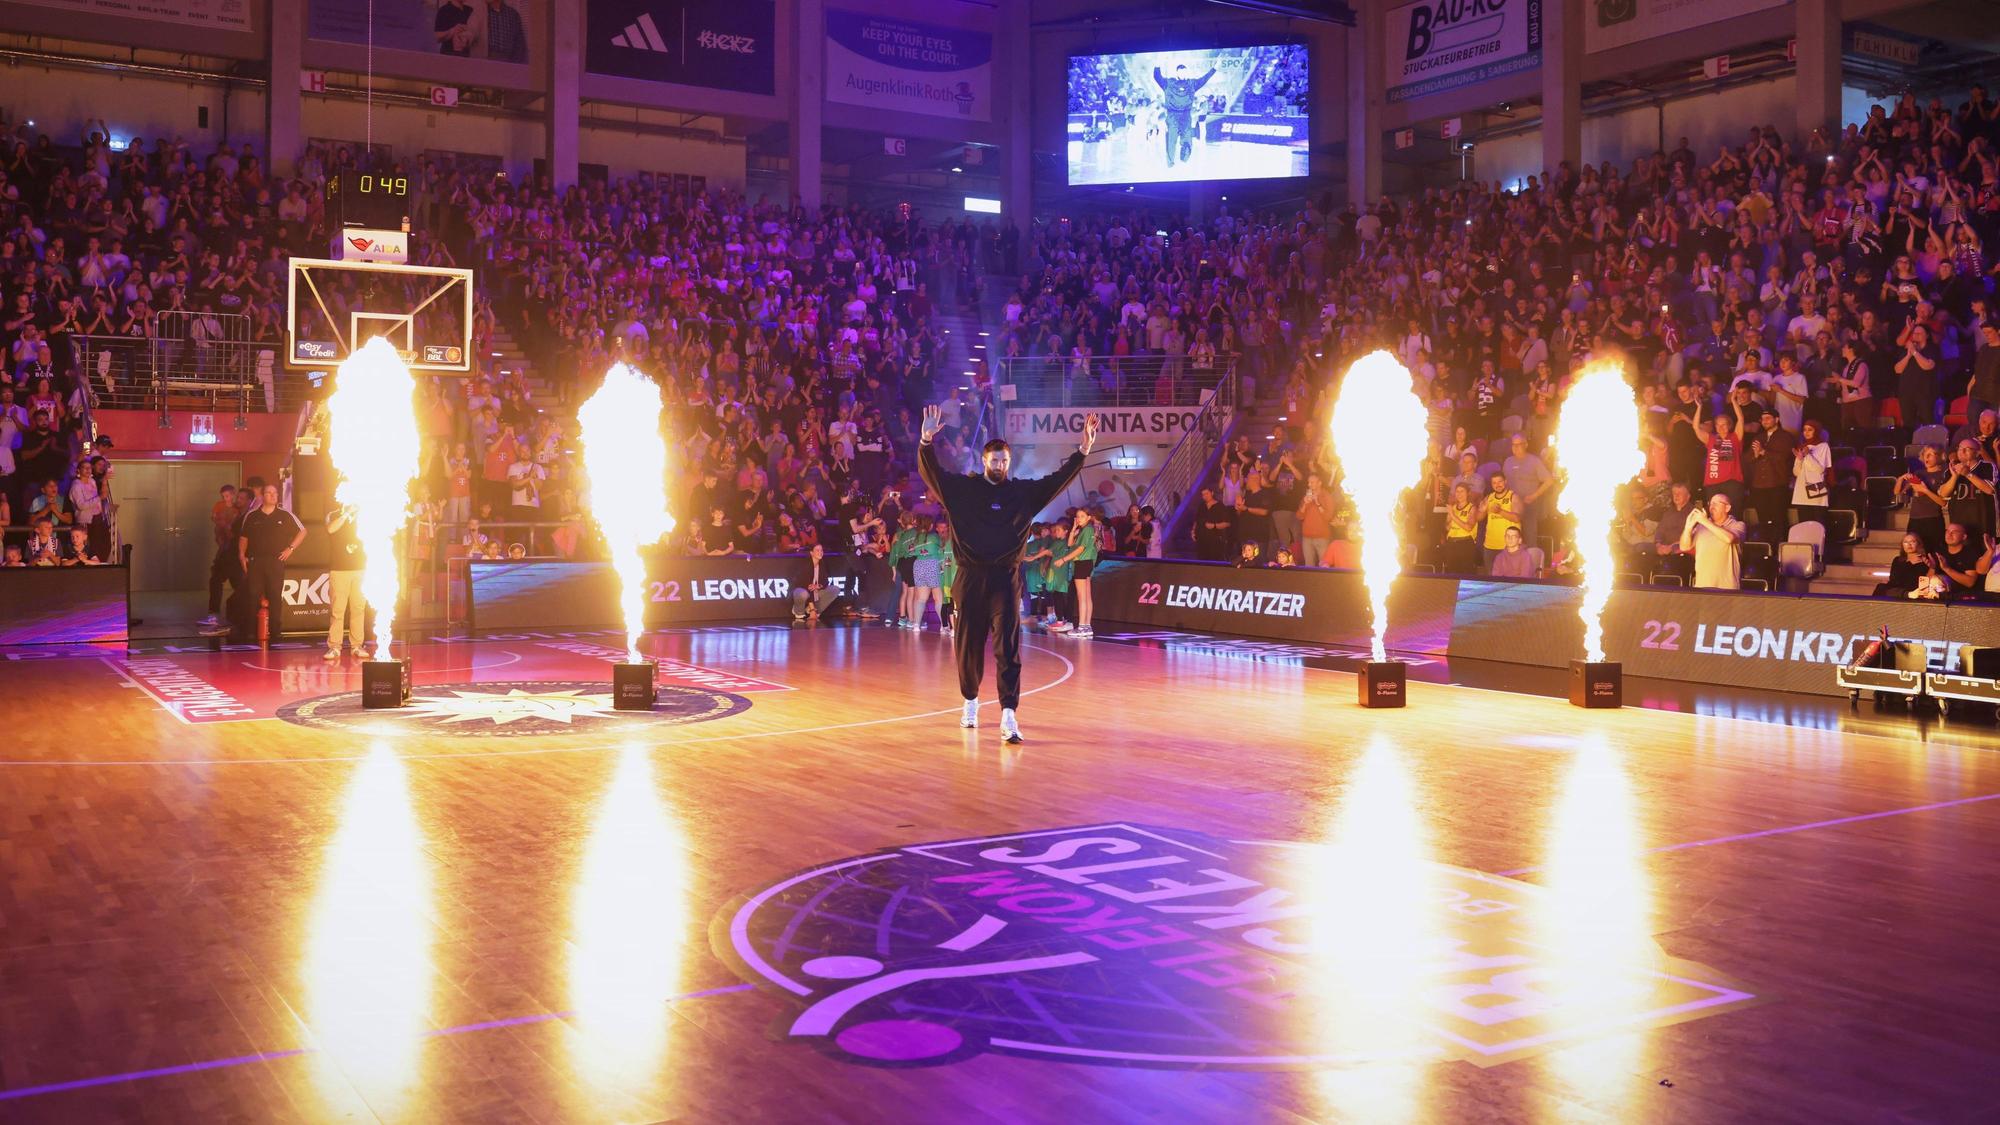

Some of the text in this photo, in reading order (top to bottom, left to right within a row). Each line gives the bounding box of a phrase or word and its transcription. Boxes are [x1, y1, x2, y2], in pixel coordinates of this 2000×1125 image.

[188, 12, 208, 20] EVENT
[217, 15, 245, 24] TECHNIK
[862, 26, 953, 52] KEEP YOUR EYES
[878, 43, 961, 67] ON THE COURT.
[1404, 40, 1501, 76] STUCKATEURBETRIEB
[1488, 55, 1539, 78] SANIERUNG
[1717, 57, 1729, 76] E
[310, 73, 325, 92] H
[846, 73, 954, 103] AugenklinikRoth
[432, 88, 446, 104] G
[1442, 121, 1450, 138] E
[895, 140, 905, 154] G
[373, 244, 401, 254] AIDA
[299, 342, 321, 352] easy
[310, 348, 335, 358] Credit
[1032, 413, 1147, 433] MAGNTA
[650, 581, 681, 602] 22
[690, 579, 754, 601] LEON
[1138, 583, 1305, 618] 22 LEON KRATZER
[293, 608, 329, 616] www.rkg.de
[1640, 620, 1970, 673] 22 LEON KRAE
